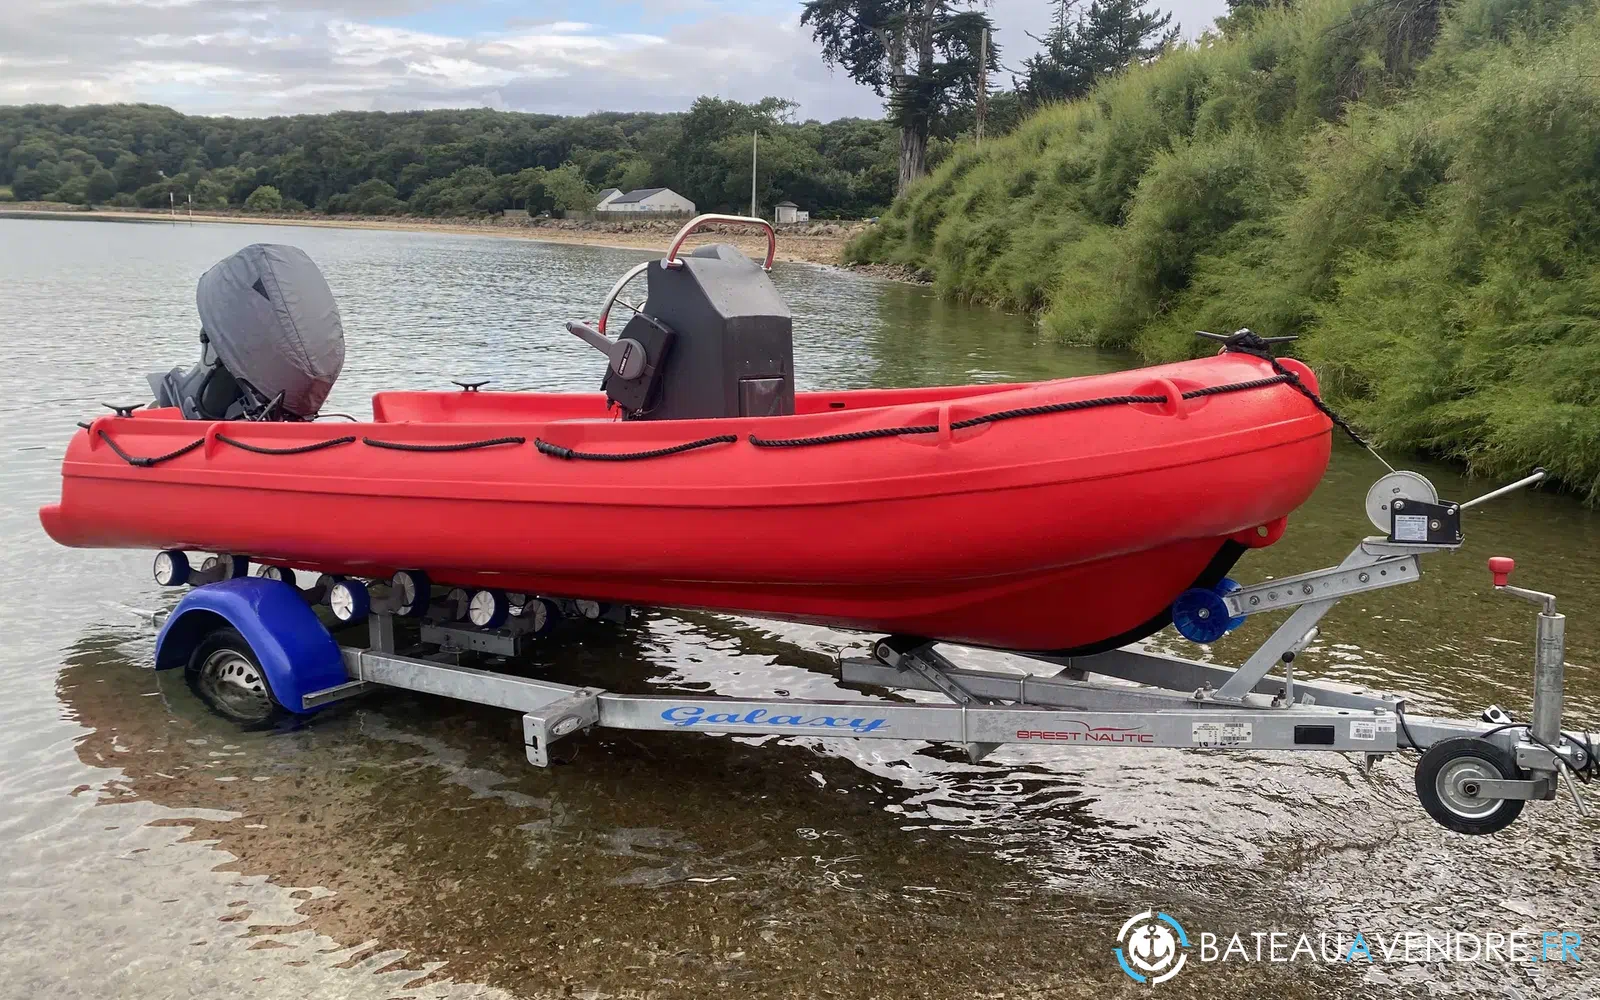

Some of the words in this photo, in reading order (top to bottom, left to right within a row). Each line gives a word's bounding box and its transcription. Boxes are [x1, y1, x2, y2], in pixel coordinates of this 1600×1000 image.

[661, 706, 891, 732] Galaxy
[1016, 730, 1081, 741] BREST
[1085, 732, 1154, 743] NAUTIC
